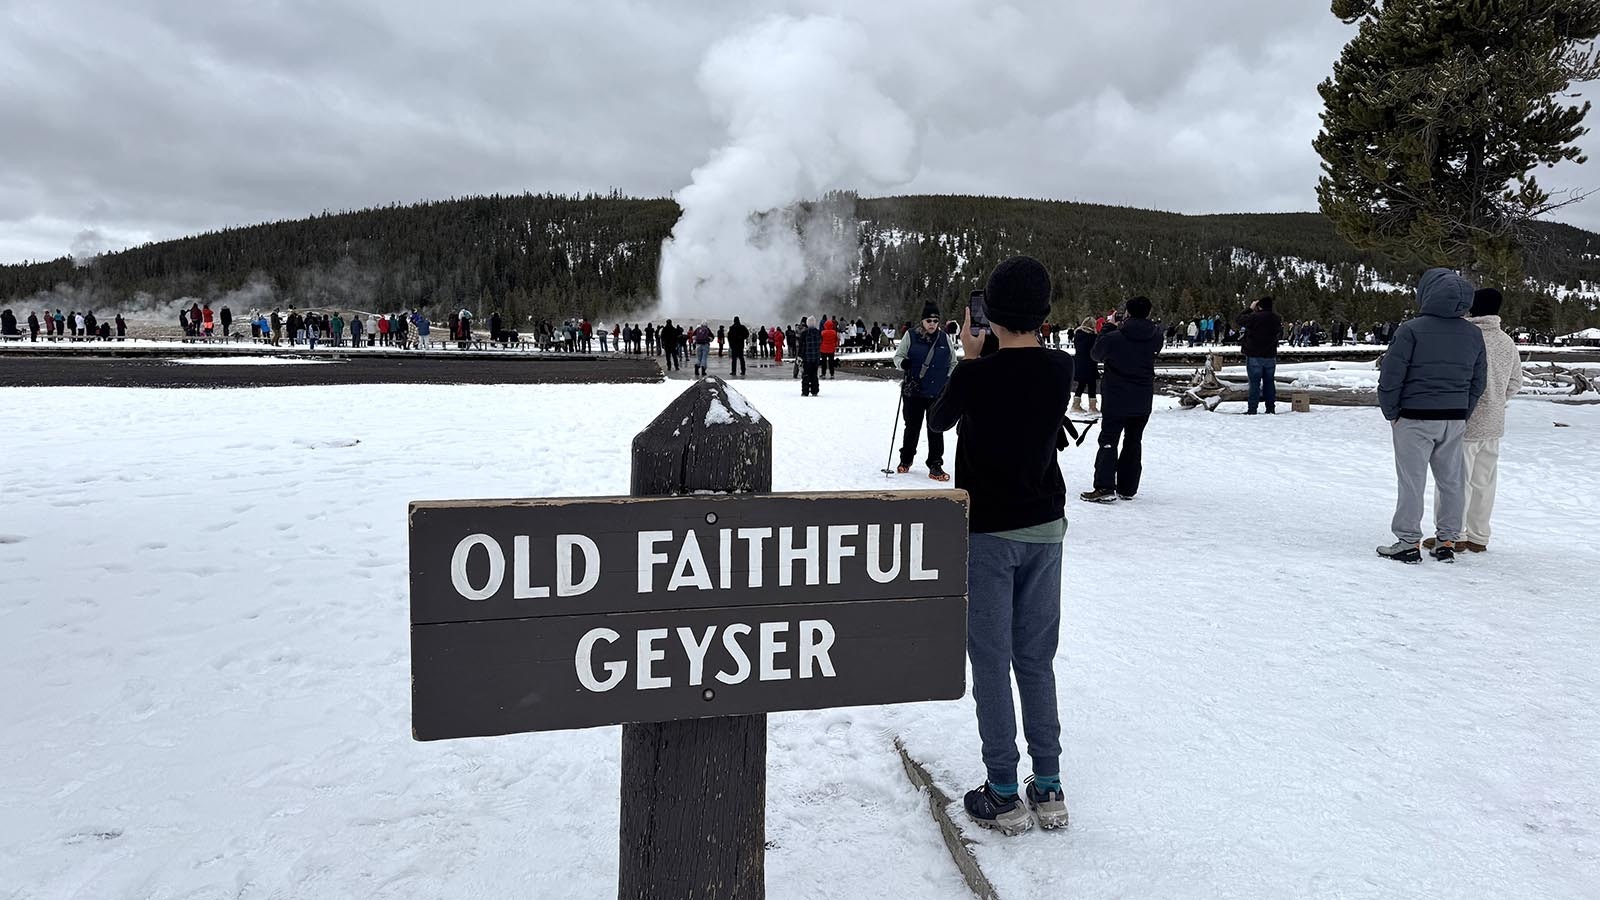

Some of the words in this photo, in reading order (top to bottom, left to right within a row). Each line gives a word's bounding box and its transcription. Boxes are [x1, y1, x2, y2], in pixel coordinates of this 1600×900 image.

[451, 534, 600, 600] OLD
[638, 523, 938, 592] FAITHFUL
[576, 620, 836, 692] GEYSER
